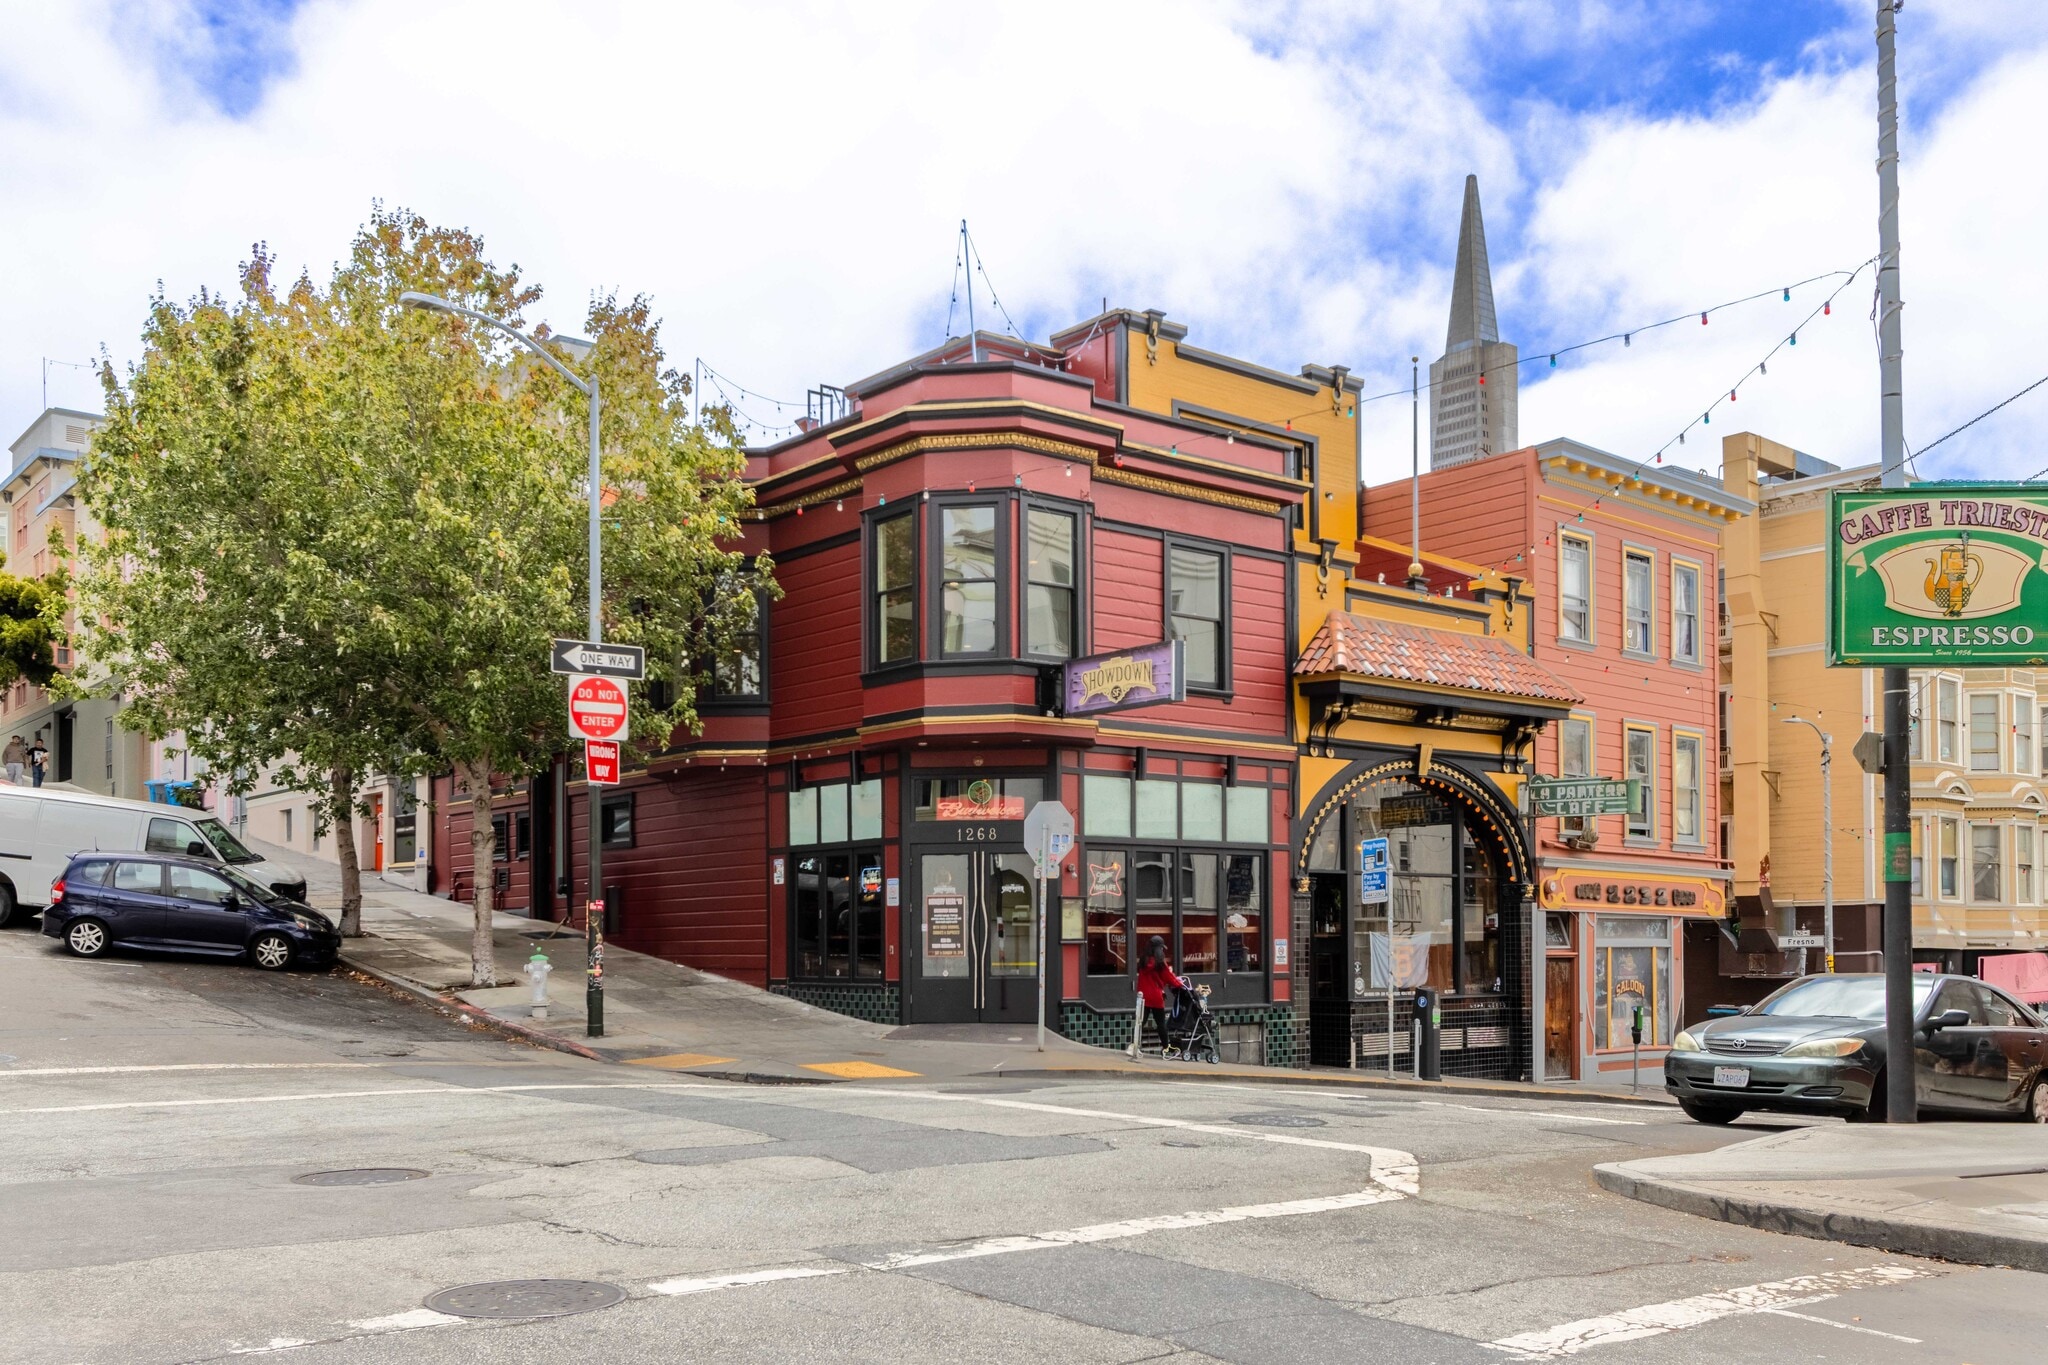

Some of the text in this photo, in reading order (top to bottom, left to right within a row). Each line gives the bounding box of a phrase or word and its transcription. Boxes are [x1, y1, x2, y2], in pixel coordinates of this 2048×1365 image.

[1839, 502, 1932, 545] CAFFE
[1871, 625, 2034, 647] ESPRESSO
[1934, 648, 1953, 656] Since
[580, 653, 632, 667] ONE WAY
[1082, 660, 1152, 697] SHOWDOWN
[578, 687, 619, 701] DO NOT
[581, 715, 615, 727] ENTER
[589, 745, 616, 760] WRONG
[595, 765, 610, 778] WAY
[1530, 784, 1627, 800] LA PANTERA
[937, 802, 1023, 817] Budweiser
[1556, 801, 1604, 814] CAFE
[957, 828, 997, 841] 1268
[1615, 979, 1645, 998] SALOON
